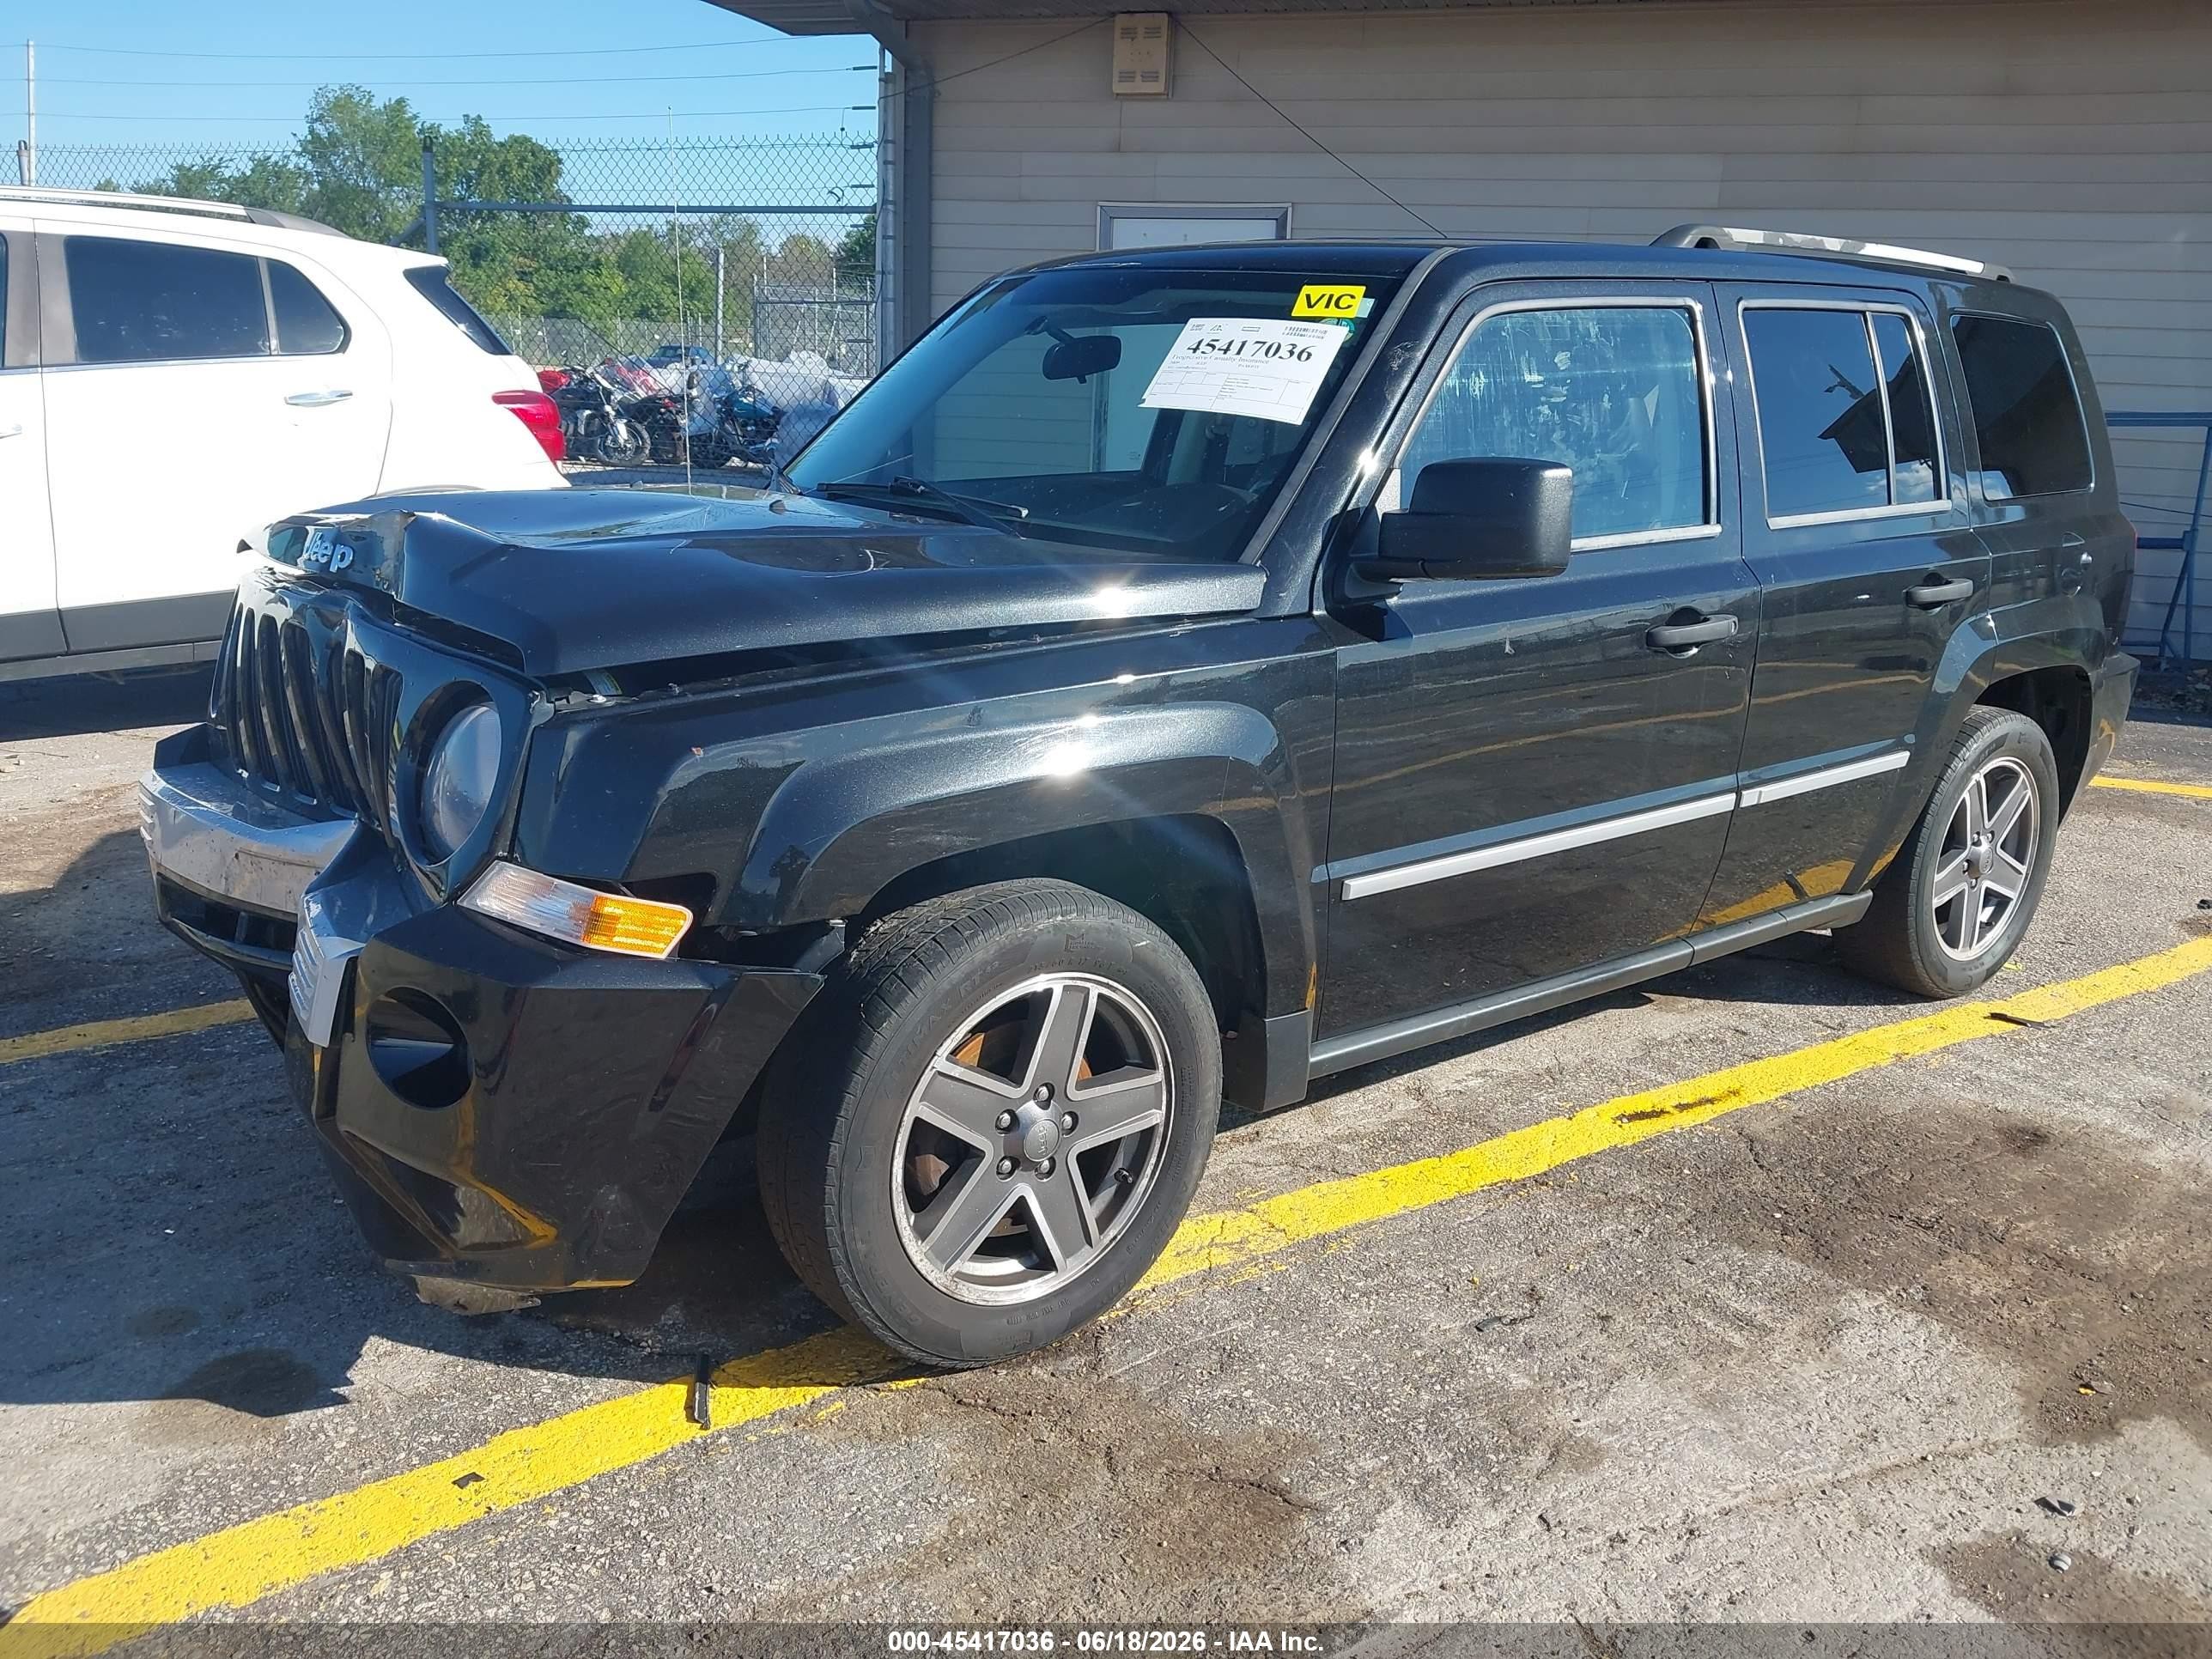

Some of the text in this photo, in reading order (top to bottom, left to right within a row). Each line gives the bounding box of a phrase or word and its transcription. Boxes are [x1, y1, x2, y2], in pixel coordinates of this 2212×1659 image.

[1304, 293, 1356, 310] VIC
[1187, 338, 1318, 362] 45417036
[303, 532, 354, 573] Jeep
